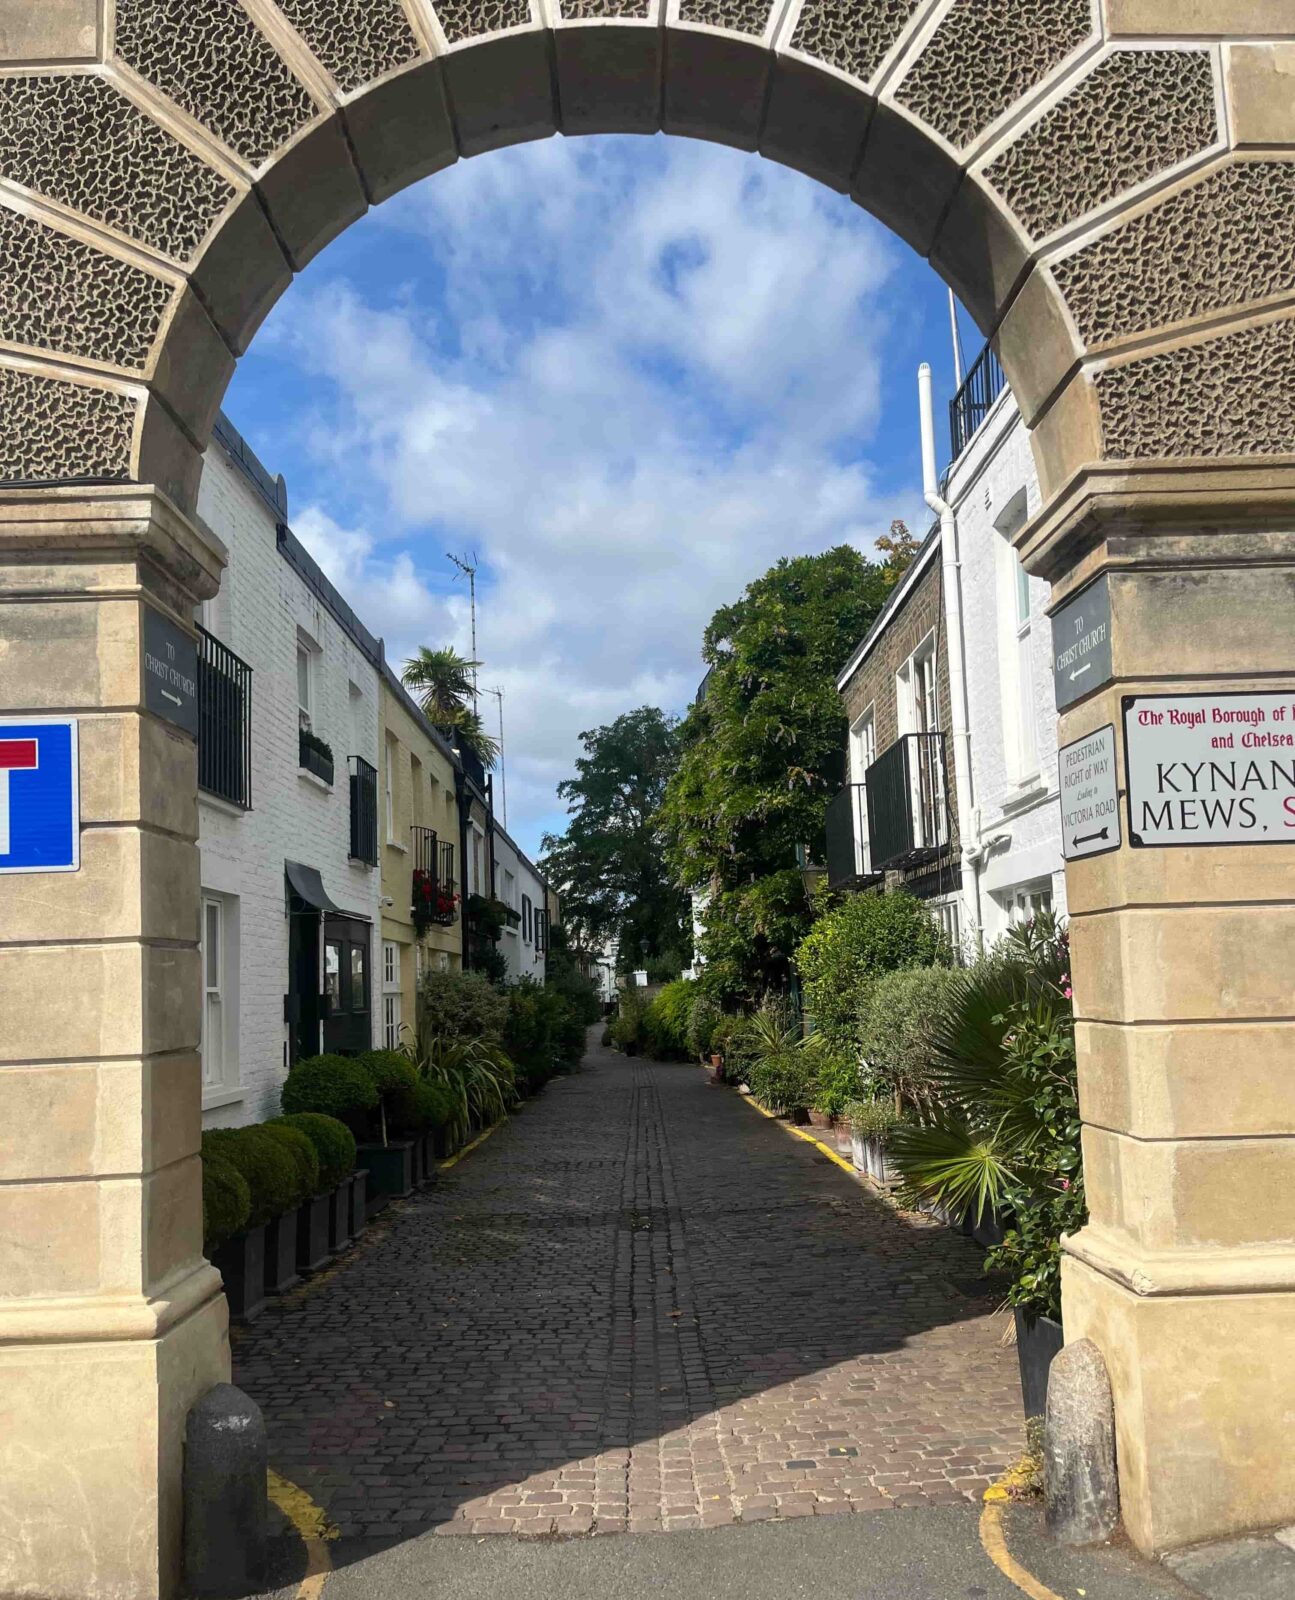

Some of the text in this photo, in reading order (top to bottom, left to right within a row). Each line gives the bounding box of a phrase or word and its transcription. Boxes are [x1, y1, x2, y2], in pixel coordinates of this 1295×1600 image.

[1074, 616, 1084, 635] TO
[165, 642, 176, 661] TO
[1056, 622, 1106, 672] CHRIST CHURCH
[145, 652, 195, 698] CHRIST CHURCH
[1138, 710, 1164, 726] The
[1167, 708, 1206, 729] Royal
[1212, 707, 1265, 727] Borough
[1272, 706, 1286, 721] of
[1065, 737, 1105, 768] PEDESTRIAN
[1211, 731, 1294, 749] and Chelsea
[1064, 757, 1109, 789] RIGHT of WAY
[1063, 798, 1116, 828] VICTORIA ROAD
[1142, 797, 1268, 832] MEWS,
